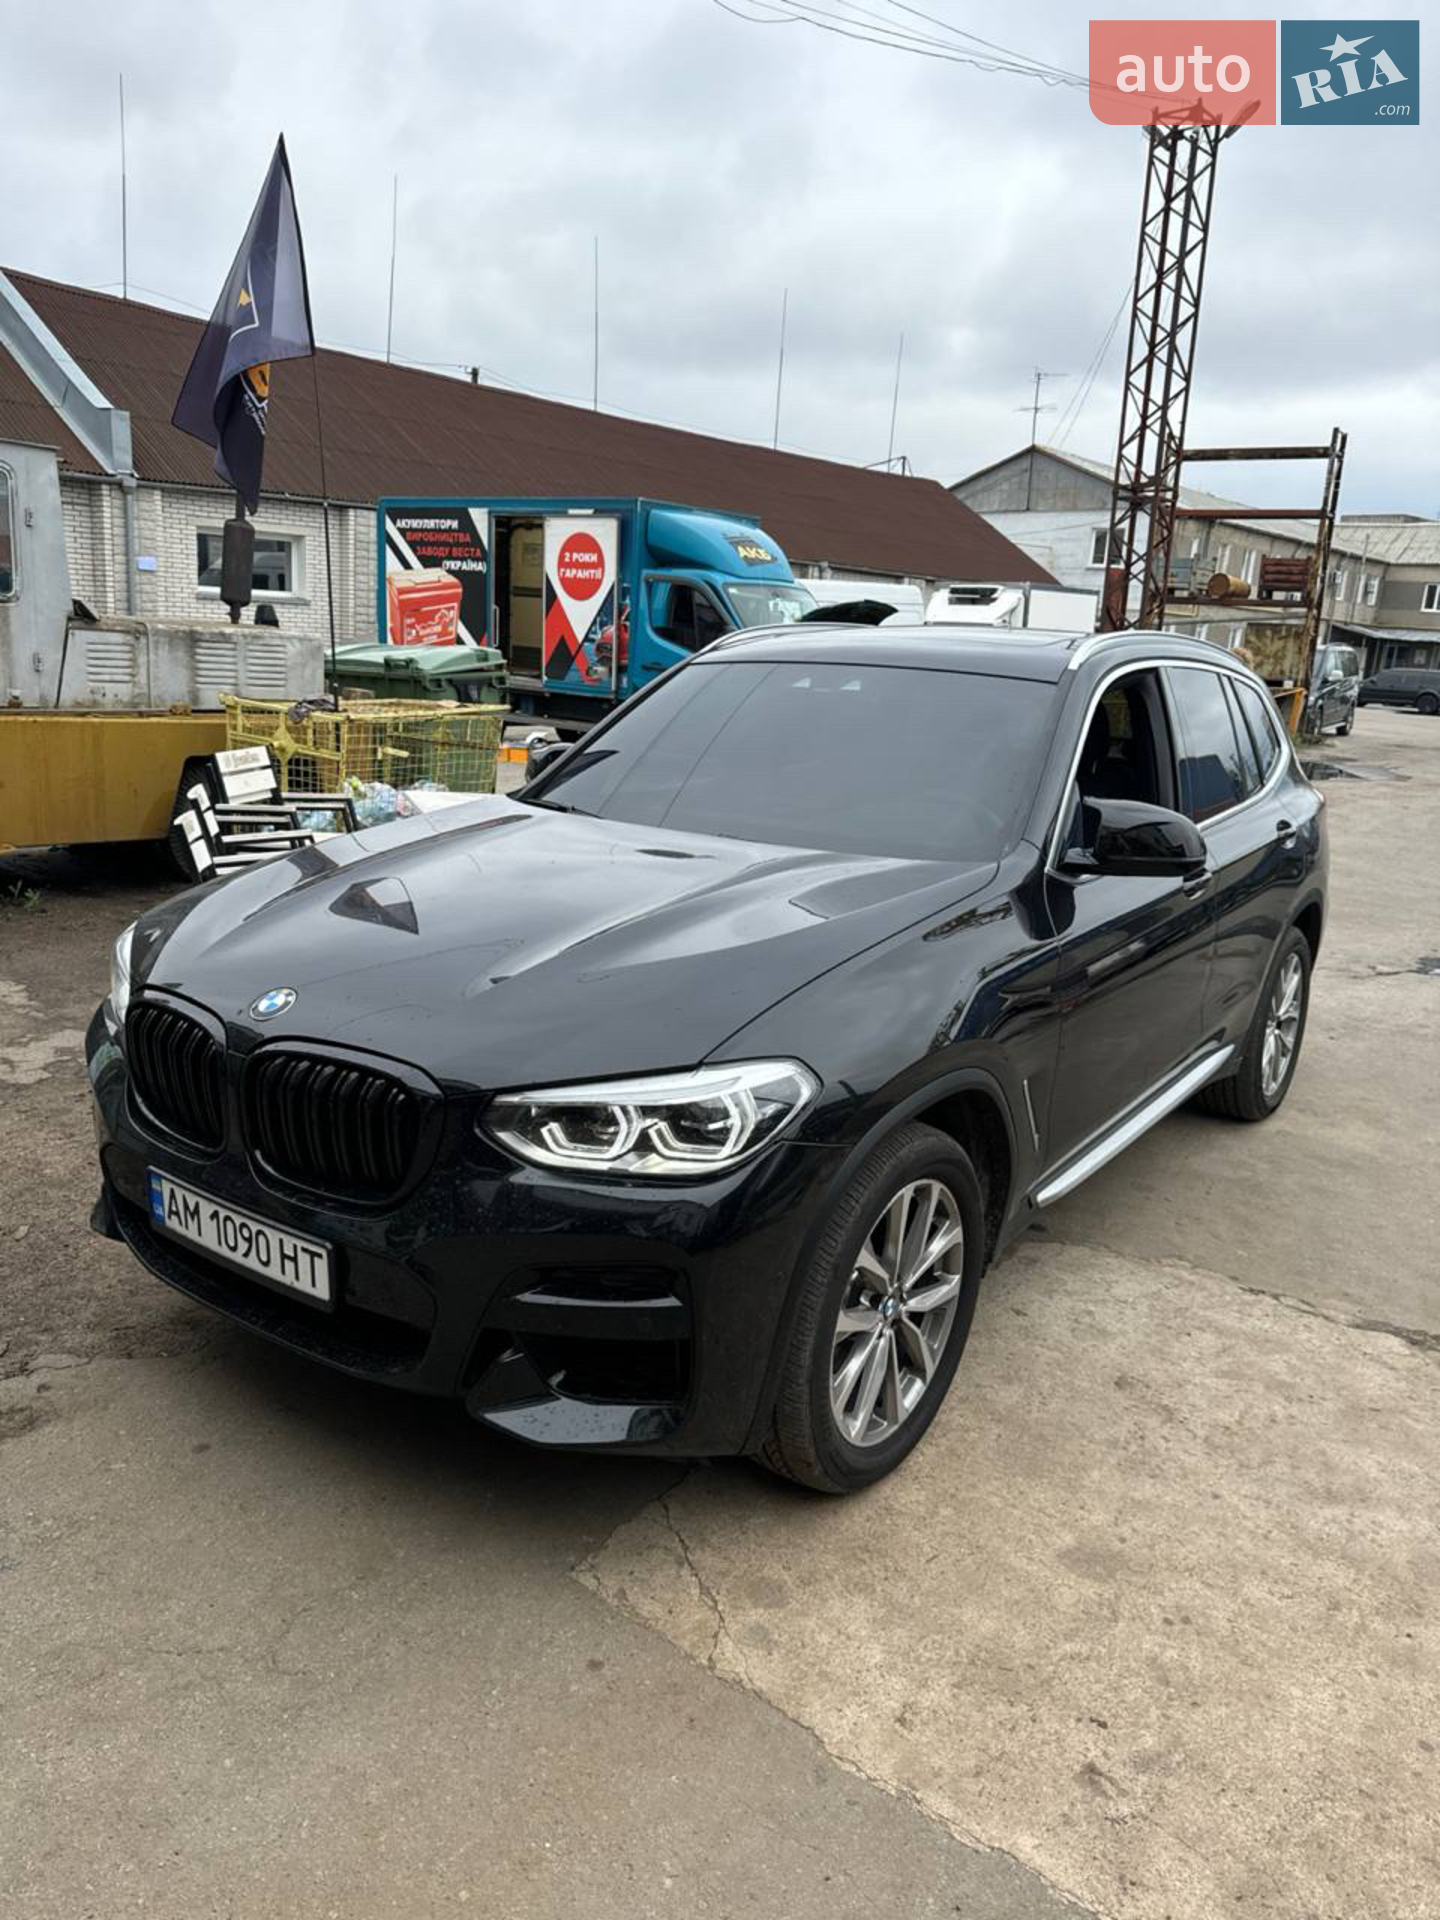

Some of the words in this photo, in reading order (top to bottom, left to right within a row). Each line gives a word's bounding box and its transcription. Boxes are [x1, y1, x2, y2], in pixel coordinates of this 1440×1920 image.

[395, 518, 459, 530] АКУМУЛЯТОРИ
[406, 531, 471, 544] ВИРОБНИЦТВА
[415, 546, 450, 558] ЗАВОДУ
[452, 547, 482, 558] ВЕСТА
[563, 552, 571, 562] 2
[572, 552, 598, 563] РОКИ
[442, 559, 487, 574] (УКРАЇНА)
[559, 567, 603, 580] ГАРАНТІЇ
[167, 1187, 202, 1237] AM
[209, 1209, 272, 1268] 1090
[278, 1238, 324, 1288] HT
